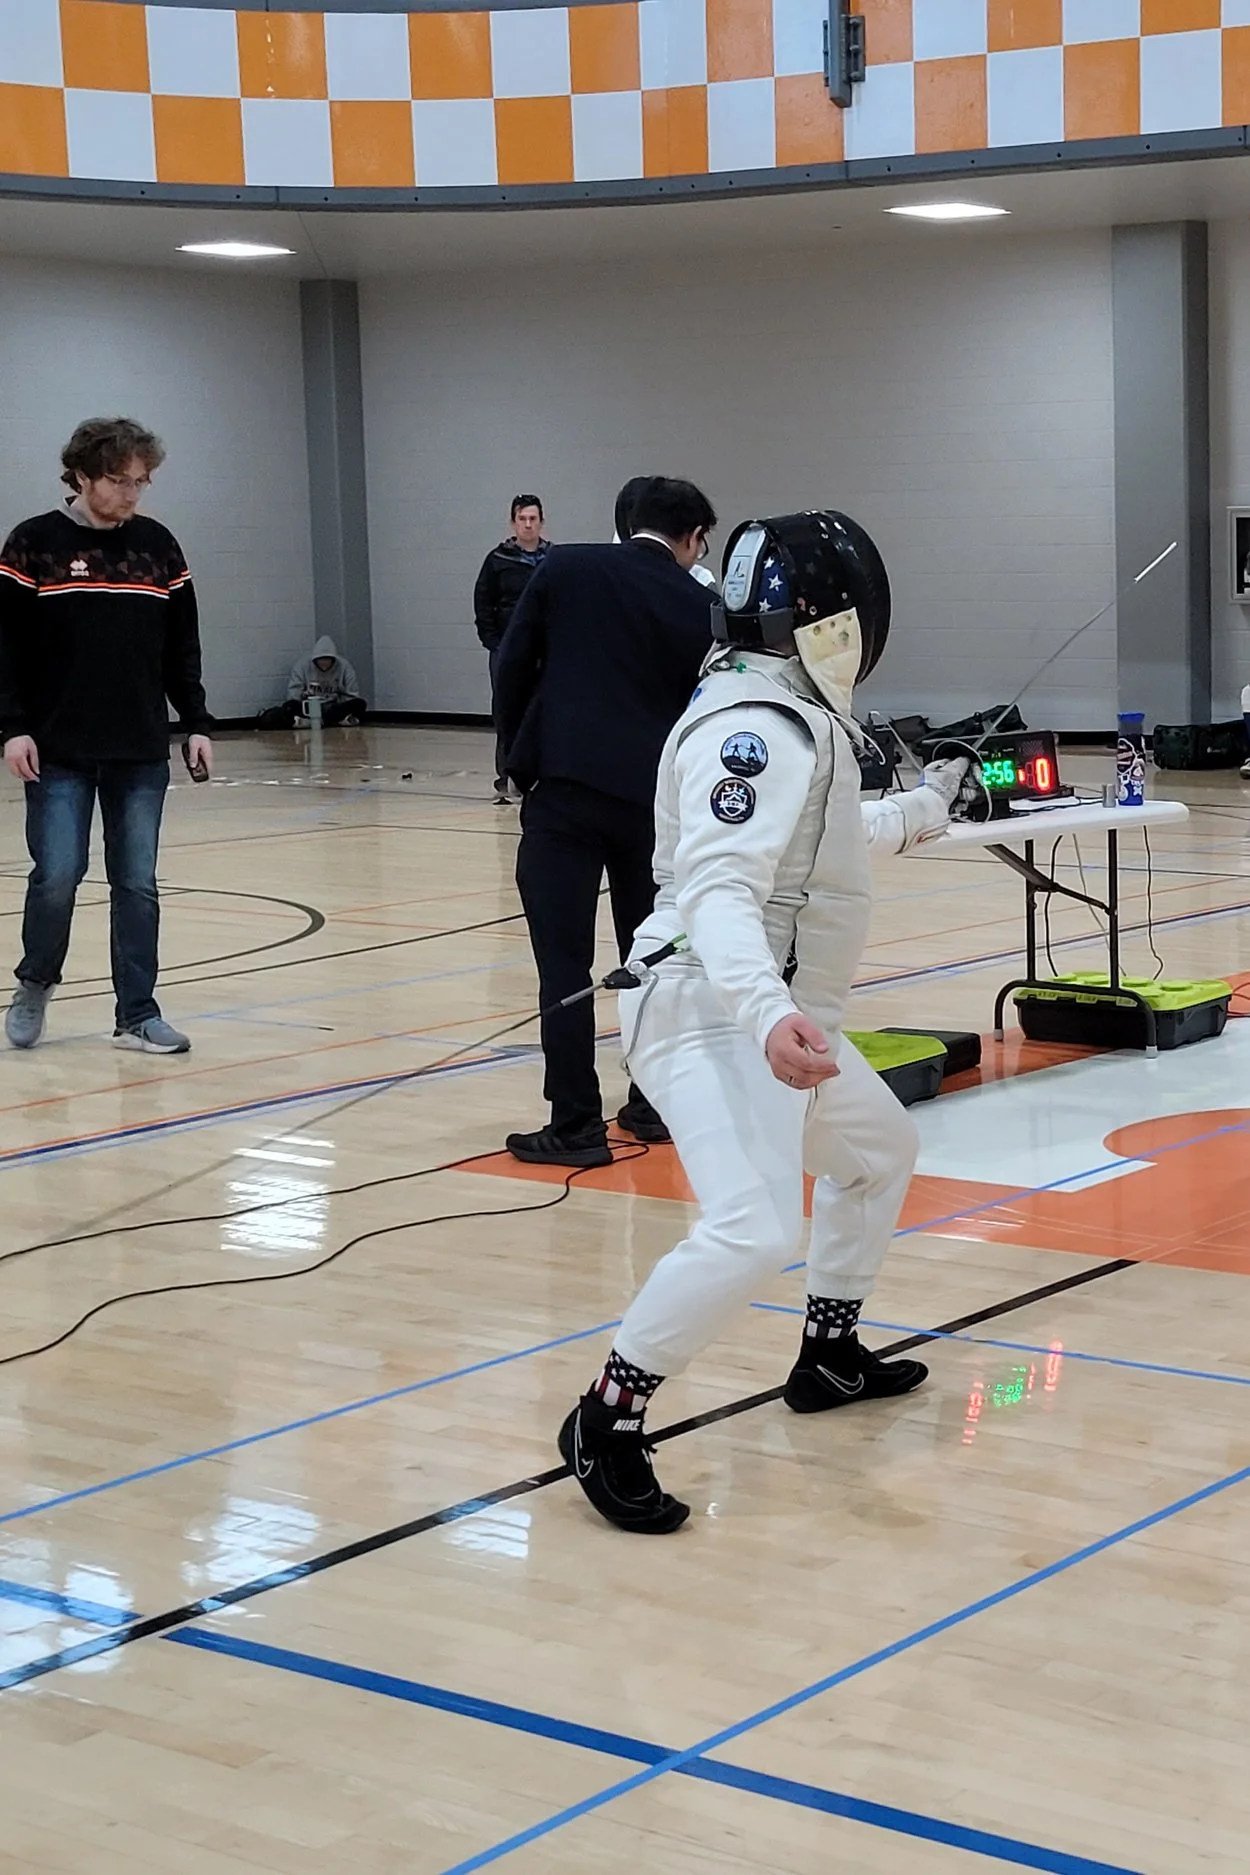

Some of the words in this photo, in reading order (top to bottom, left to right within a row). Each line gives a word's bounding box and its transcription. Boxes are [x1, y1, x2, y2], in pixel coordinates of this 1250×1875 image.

[983, 760, 1014, 785] 2:56
[1036, 757, 1050, 791] 0
[612, 1419, 641, 1431] NIKE
